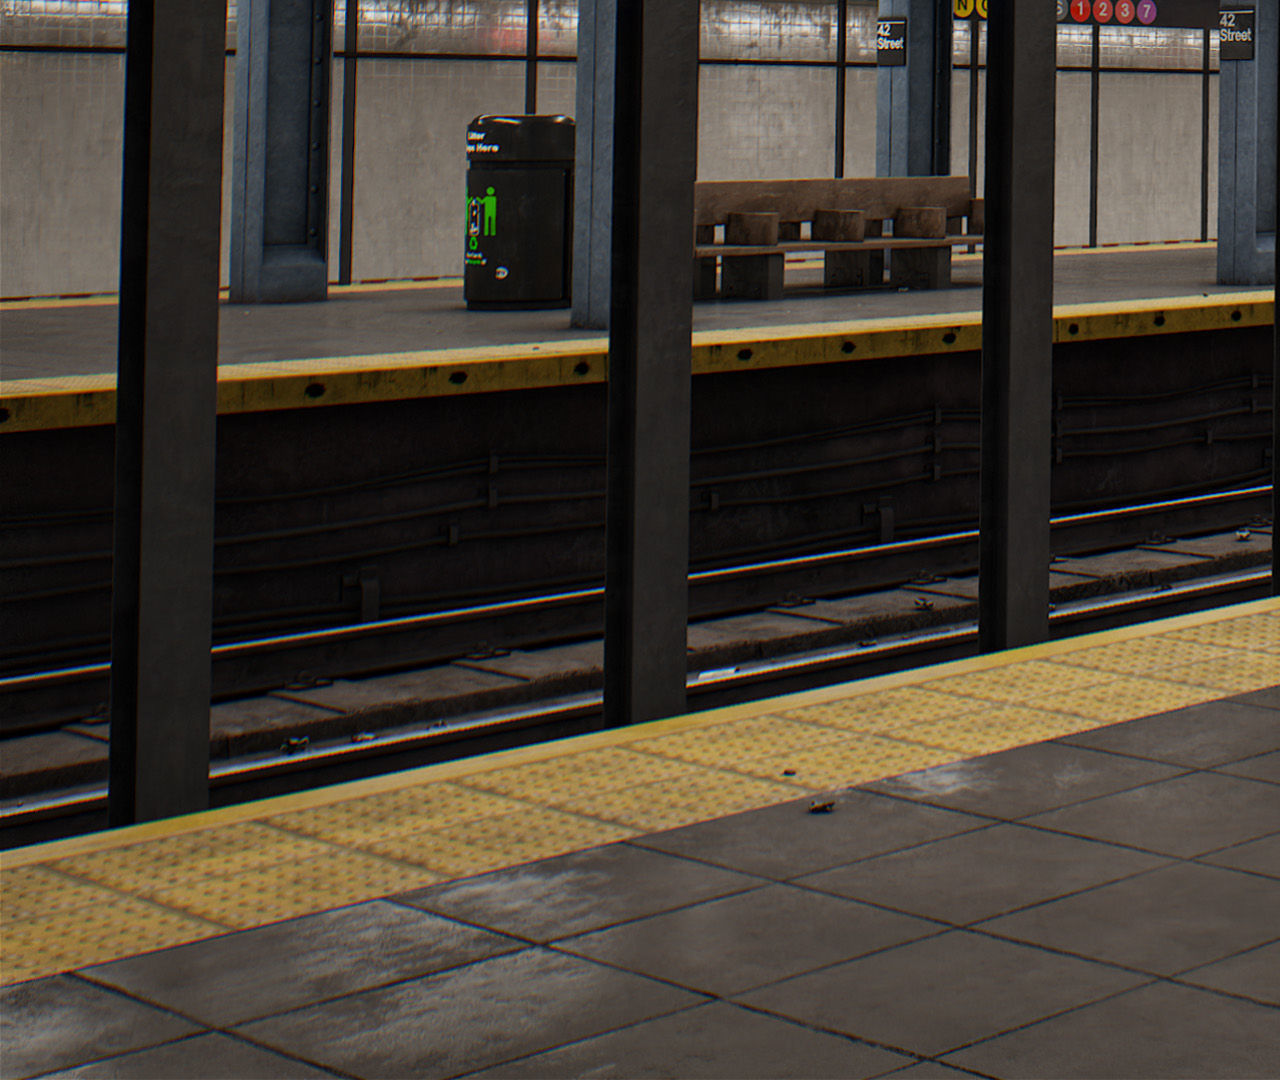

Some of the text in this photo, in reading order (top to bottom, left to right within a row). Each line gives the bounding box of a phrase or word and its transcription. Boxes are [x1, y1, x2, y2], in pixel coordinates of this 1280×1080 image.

[1077, 0, 1084, 16] 1
[1099, 1, 1107, 17] 2
[1121, 4, 1129, 19] 3
[1143, 4, 1151, 20] 7
[1219, 14, 1236, 28] 42
[877, 25, 891, 36] 42
[1220, 28, 1253, 42] Street
[877, 37, 904, 50] Street
